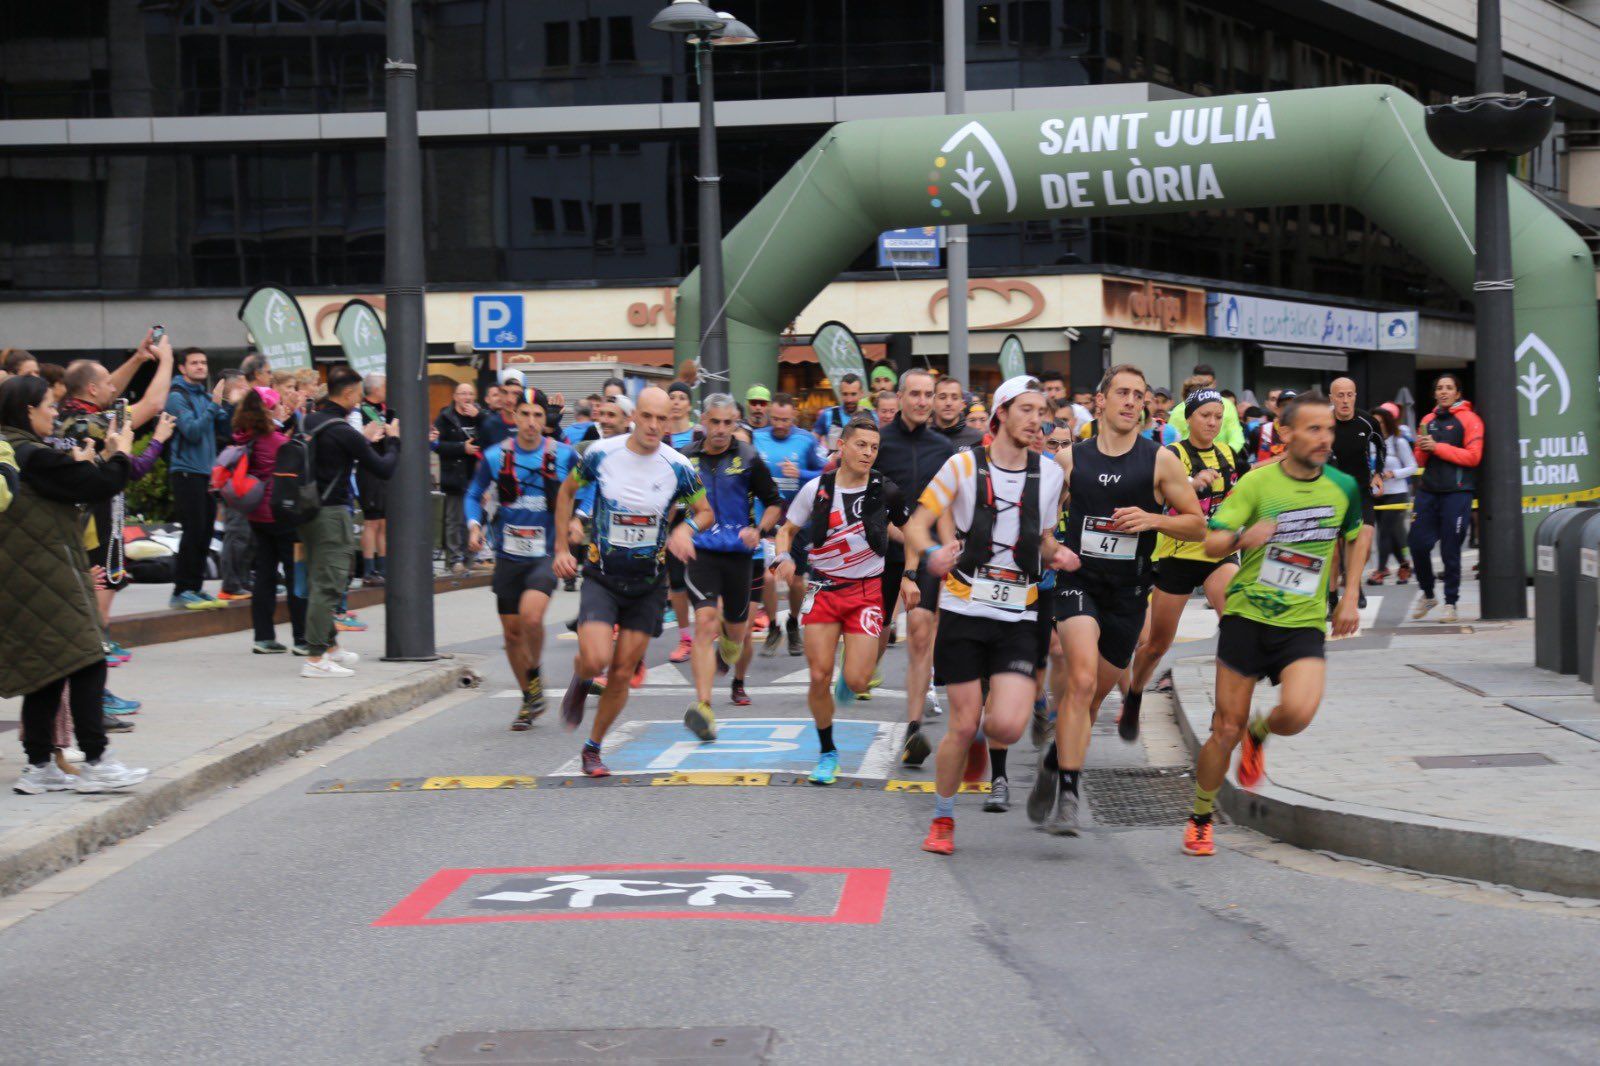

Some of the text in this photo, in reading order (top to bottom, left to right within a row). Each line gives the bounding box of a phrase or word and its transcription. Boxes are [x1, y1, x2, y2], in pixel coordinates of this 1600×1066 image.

[1039, 97, 1275, 155] SANT JULIÀ
[1040, 157, 1225, 210] DE LÒRIA
[479, 301, 511, 343] P
[1533, 431, 1589, 458] JULIÀ
[1521, 460, 1580, 486] LÒRIA
[1100, 537, 1119, 553] 47
[1277, 566, 1302, 586] 174
[991, 584, 1010, 602] 36
